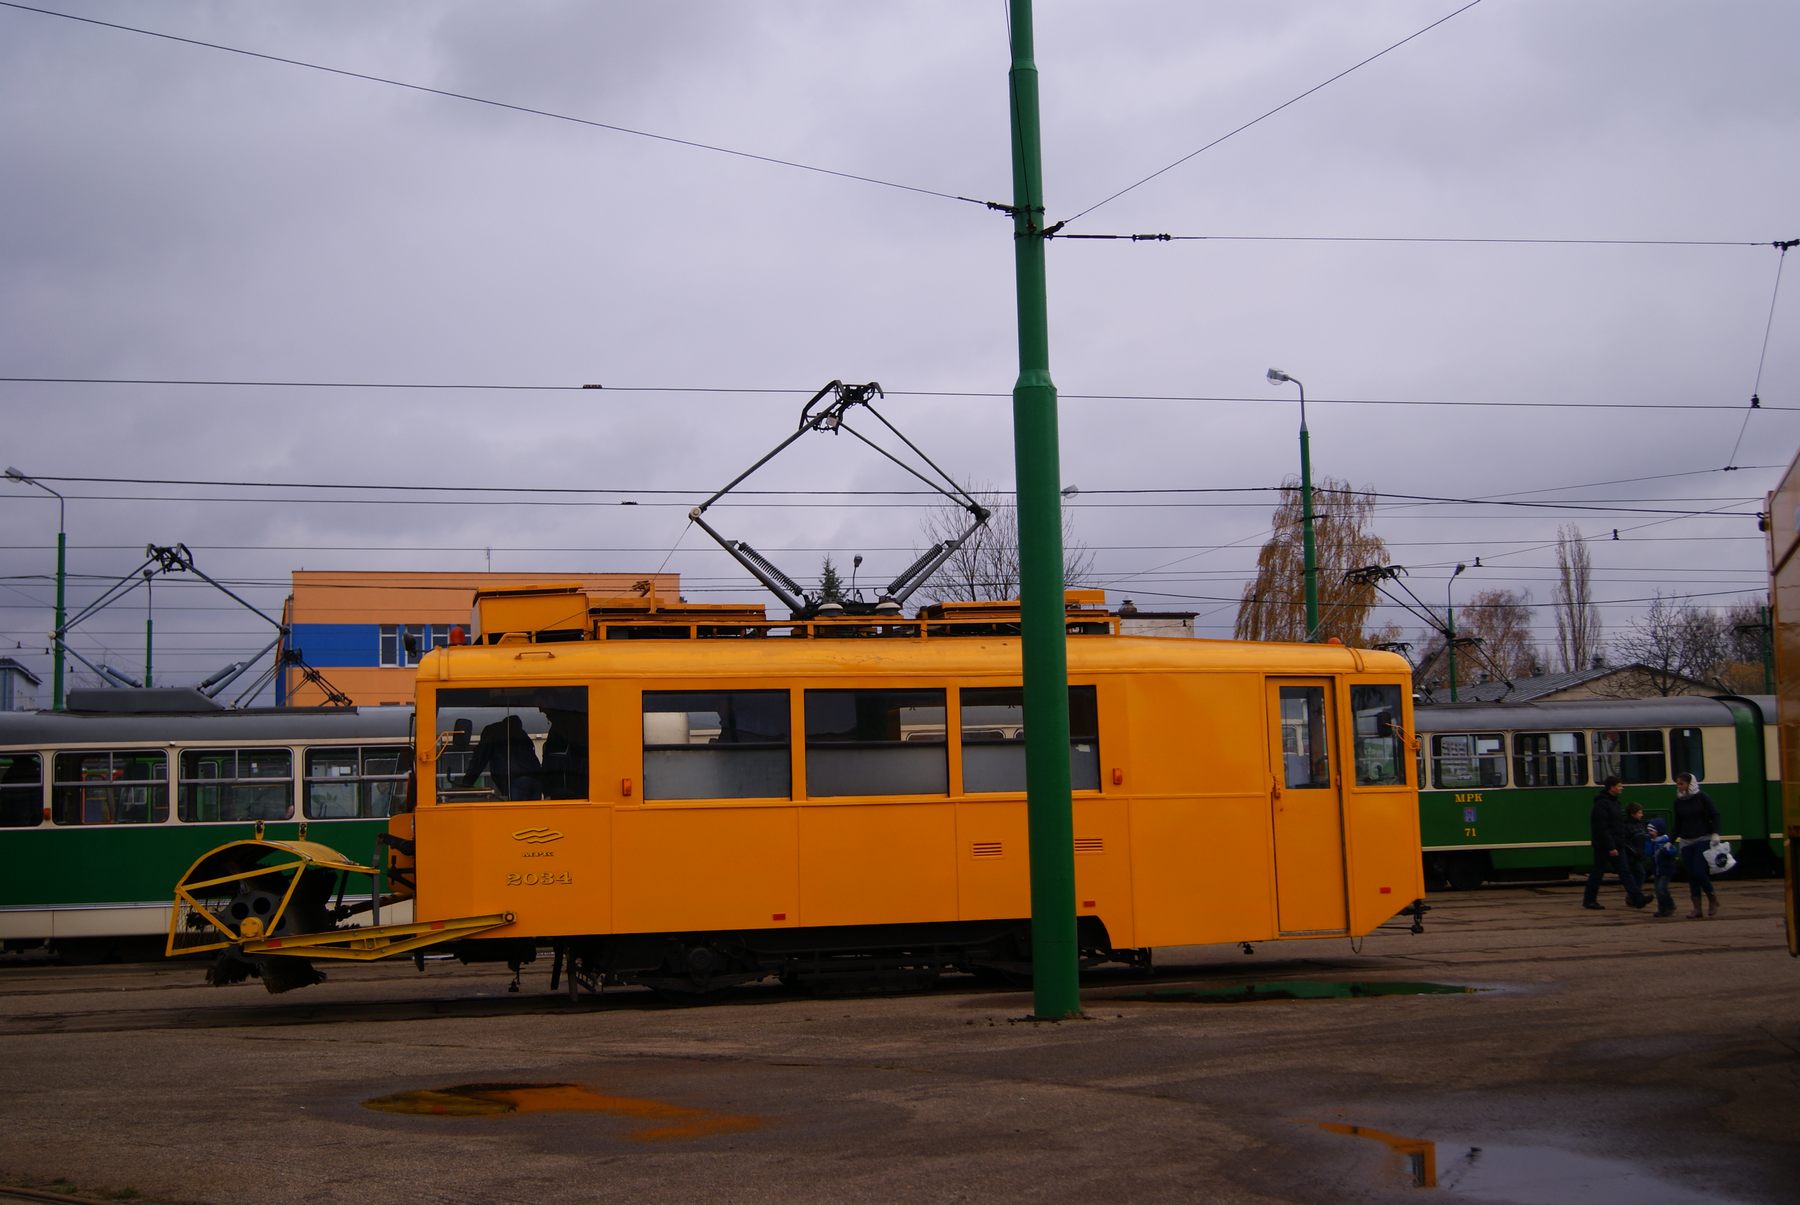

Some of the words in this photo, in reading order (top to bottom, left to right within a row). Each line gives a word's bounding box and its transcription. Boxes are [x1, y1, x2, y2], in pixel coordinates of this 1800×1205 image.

[1455, 793, 1483, 803] MPK
[1464, 827, 1476, 837] 71
[507, 871, 573, 886] 2034
